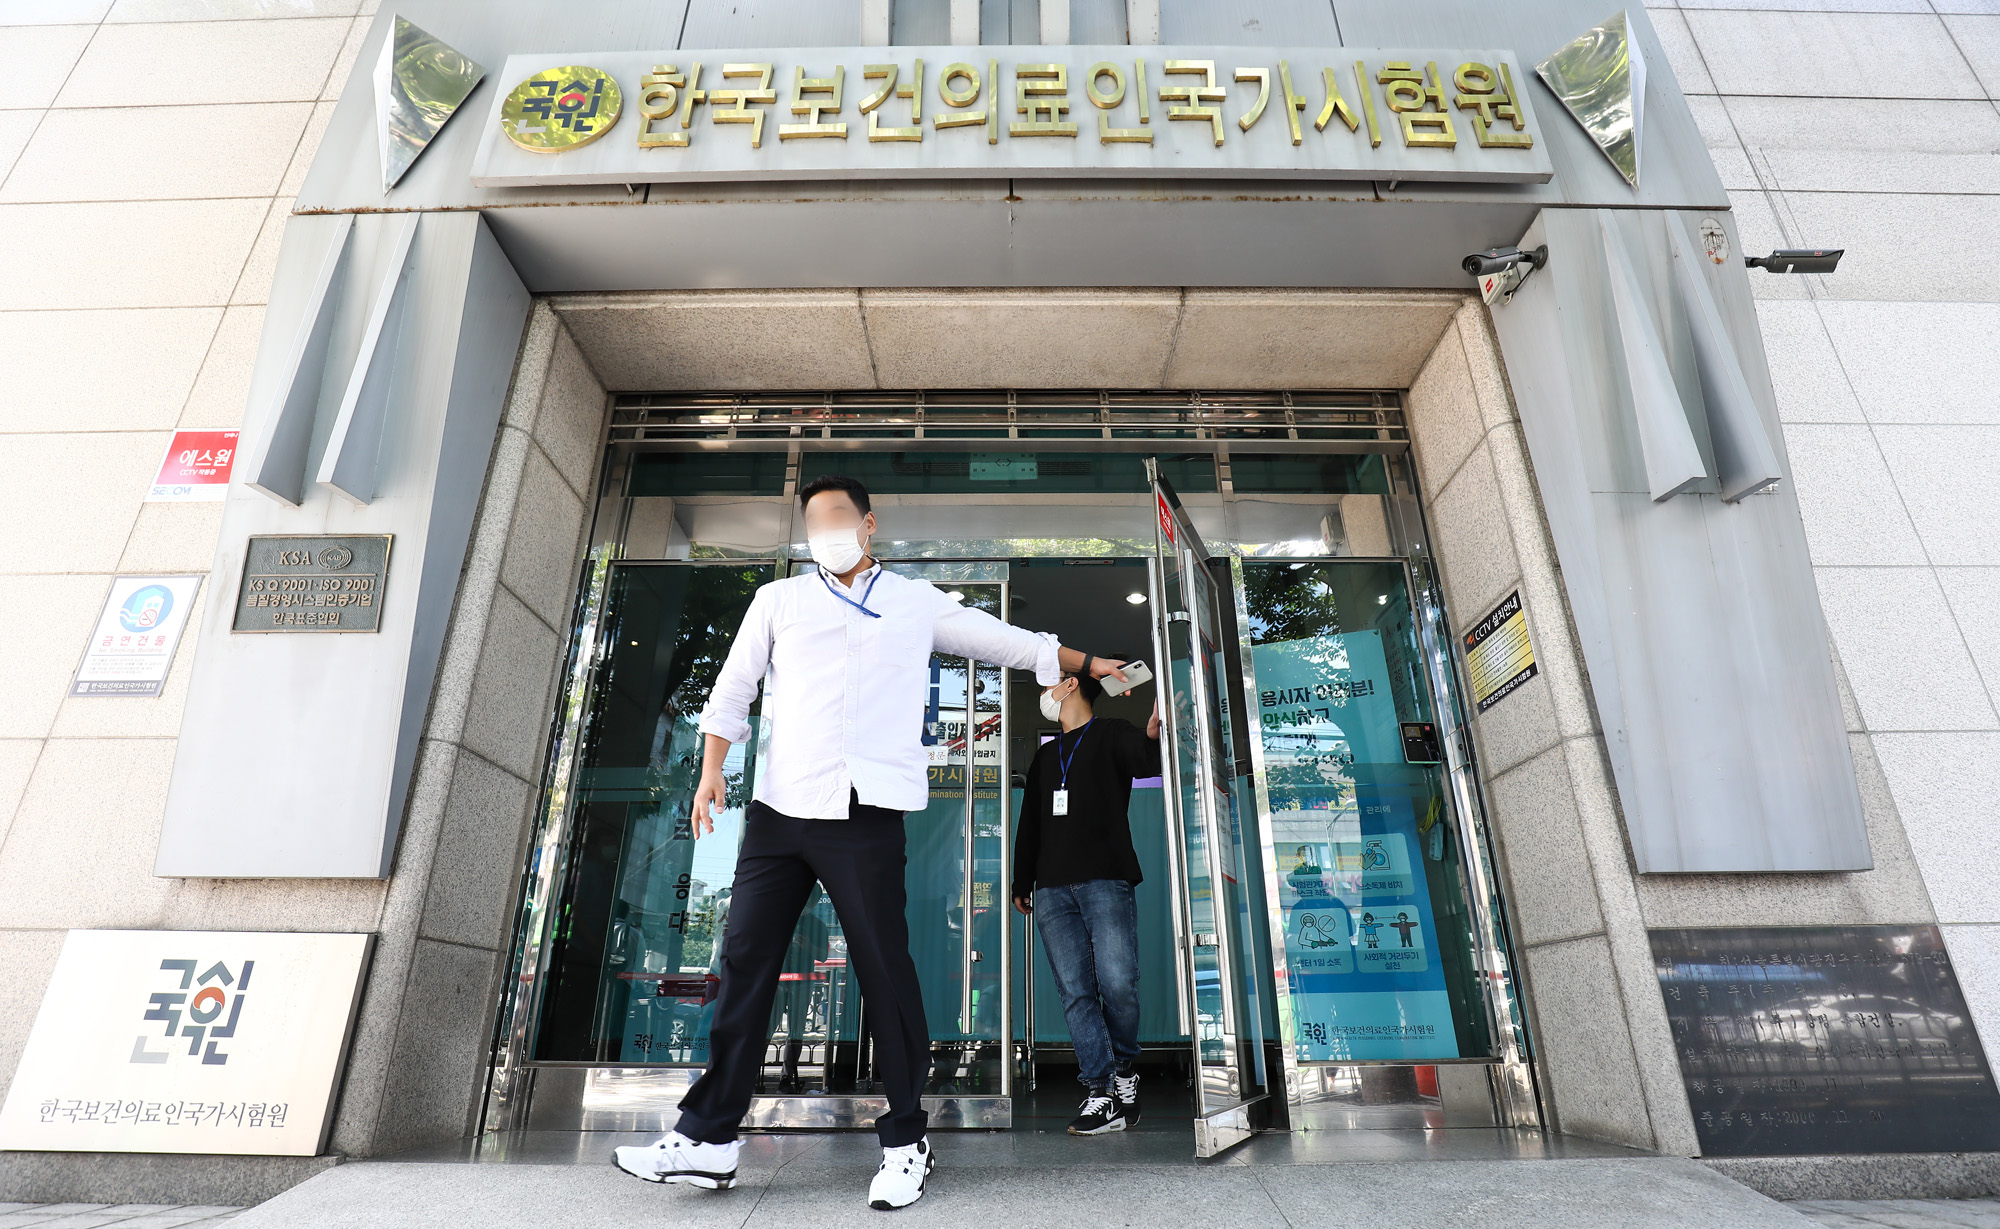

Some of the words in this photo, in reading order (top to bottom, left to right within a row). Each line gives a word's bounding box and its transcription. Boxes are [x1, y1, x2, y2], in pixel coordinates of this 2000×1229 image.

[636, 58, 1534, 149] 한국보건의료인국가시험원
[179, 449, 233, 467] 에스원
[279, 551, 312, 566] KSA
[249, 580, 264, 591] KS
[267, 580, 279, 591] Q
[345, 580, 376, 591] 9001
[273, 613, 341, 625] 한국표준협회
[1474, 621, 1492, 641] CCTV
[1491, 595, 1519, 628] 설치안내
[1260, 687, 1311, 707] 응시자
[927, 790, 964, 799] mination
[973, 790, 998, 799] stitute
[1364, 953, 1387, 961] 사회적
[1388, 951, 1420, 960] 거리두기
[1385, 961, 1401, 970] 실천
[1331, 1024, 1436, 1036] 한국보건의료인국가시험원
[40, 1098, 289, 1128] 한국보건의료인국가시험원
